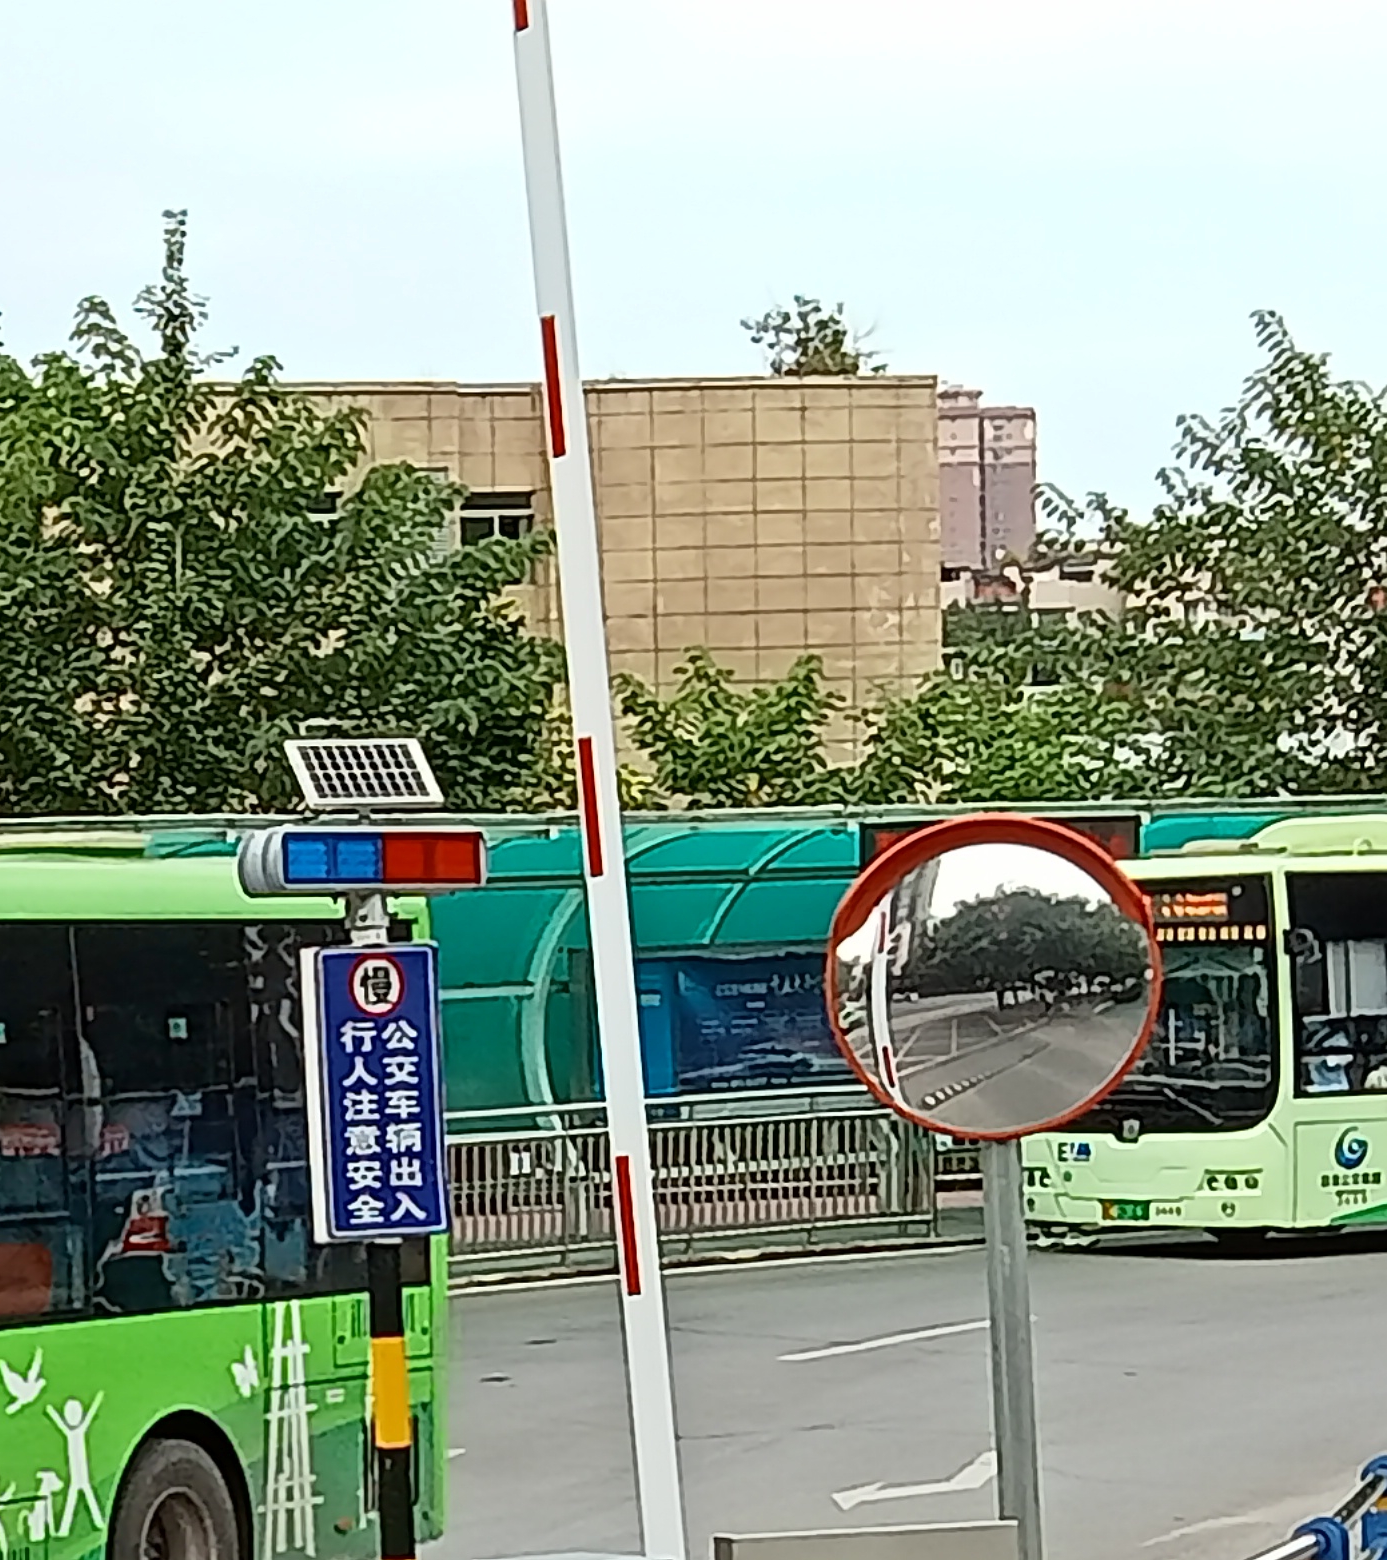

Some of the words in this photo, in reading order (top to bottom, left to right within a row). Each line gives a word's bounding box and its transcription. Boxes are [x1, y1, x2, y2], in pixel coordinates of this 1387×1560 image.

[360, 965, 394, 1006] 慢
[339, 1019, 386, 1226] 行人注意安全
[381, 1019, 428, 1222] 公交车辆出入
